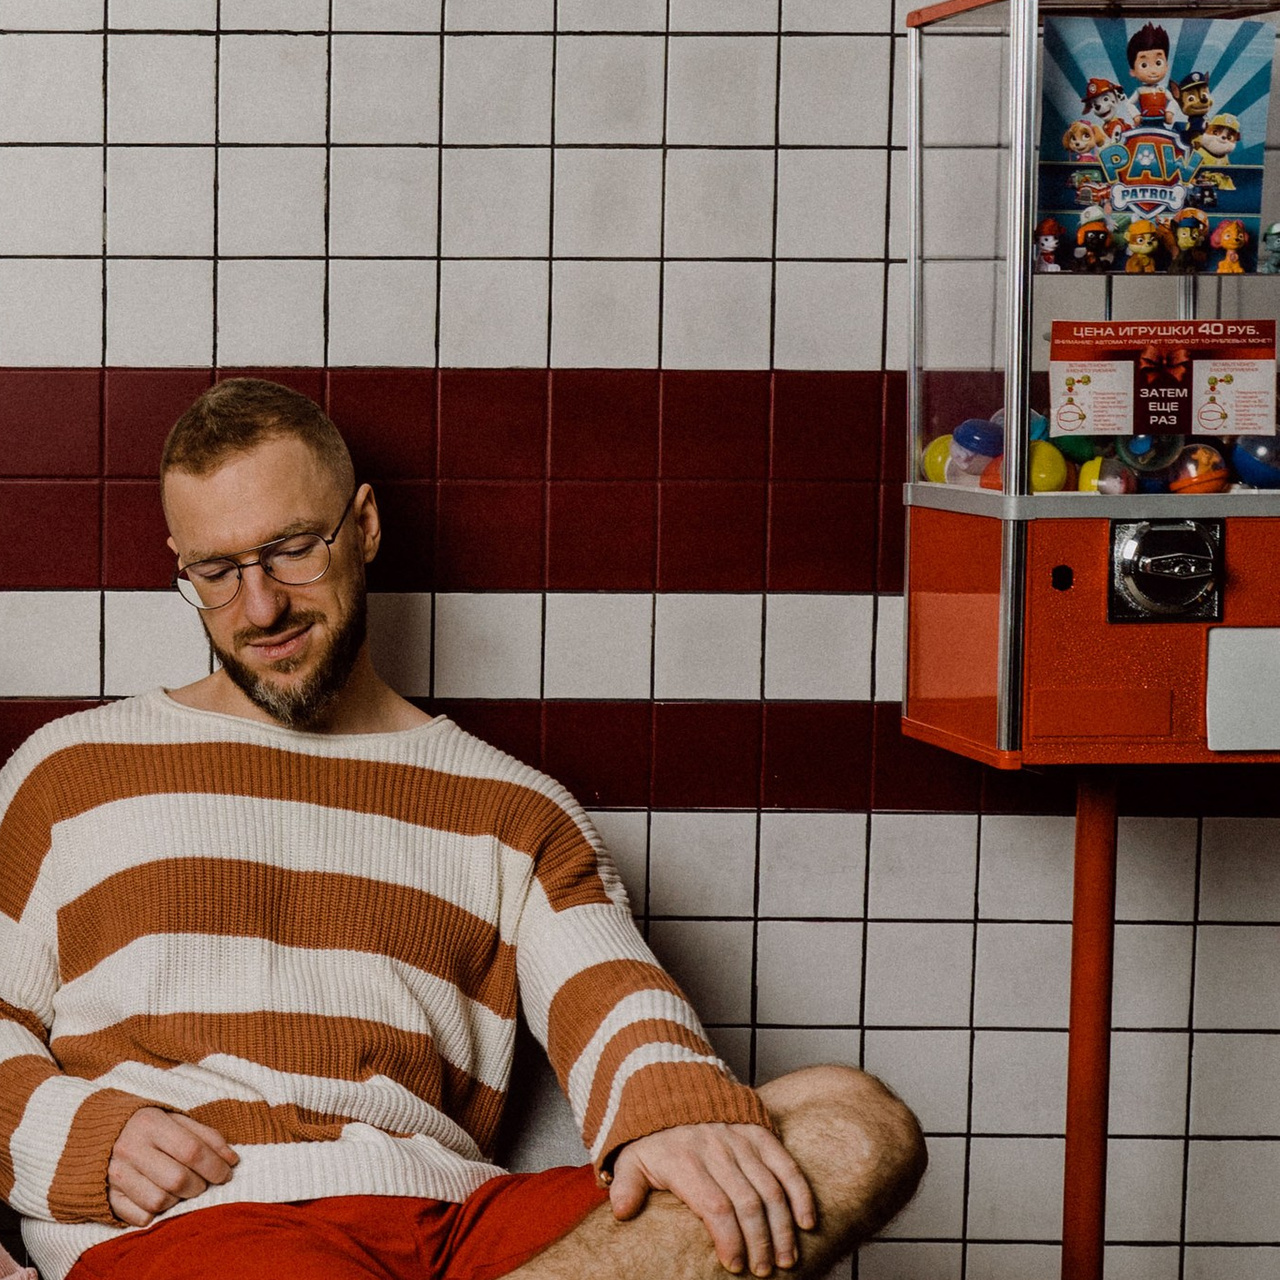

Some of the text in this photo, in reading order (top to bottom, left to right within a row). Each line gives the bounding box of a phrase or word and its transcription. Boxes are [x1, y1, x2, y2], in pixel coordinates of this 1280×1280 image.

[1099, 142, 1204, 184] PAW
[1121, 188, 1177, 201] PATROL
[1073, 323, 1260, 338] ЦЕНА ИГРУШКИ 40 РУБ.
[1139, 388, 1188, 398] ЗАТЕМ
[1148, 402, 1179, 413] ЕЩЕ
[1149, 416, 1177, 425] РАЗ
